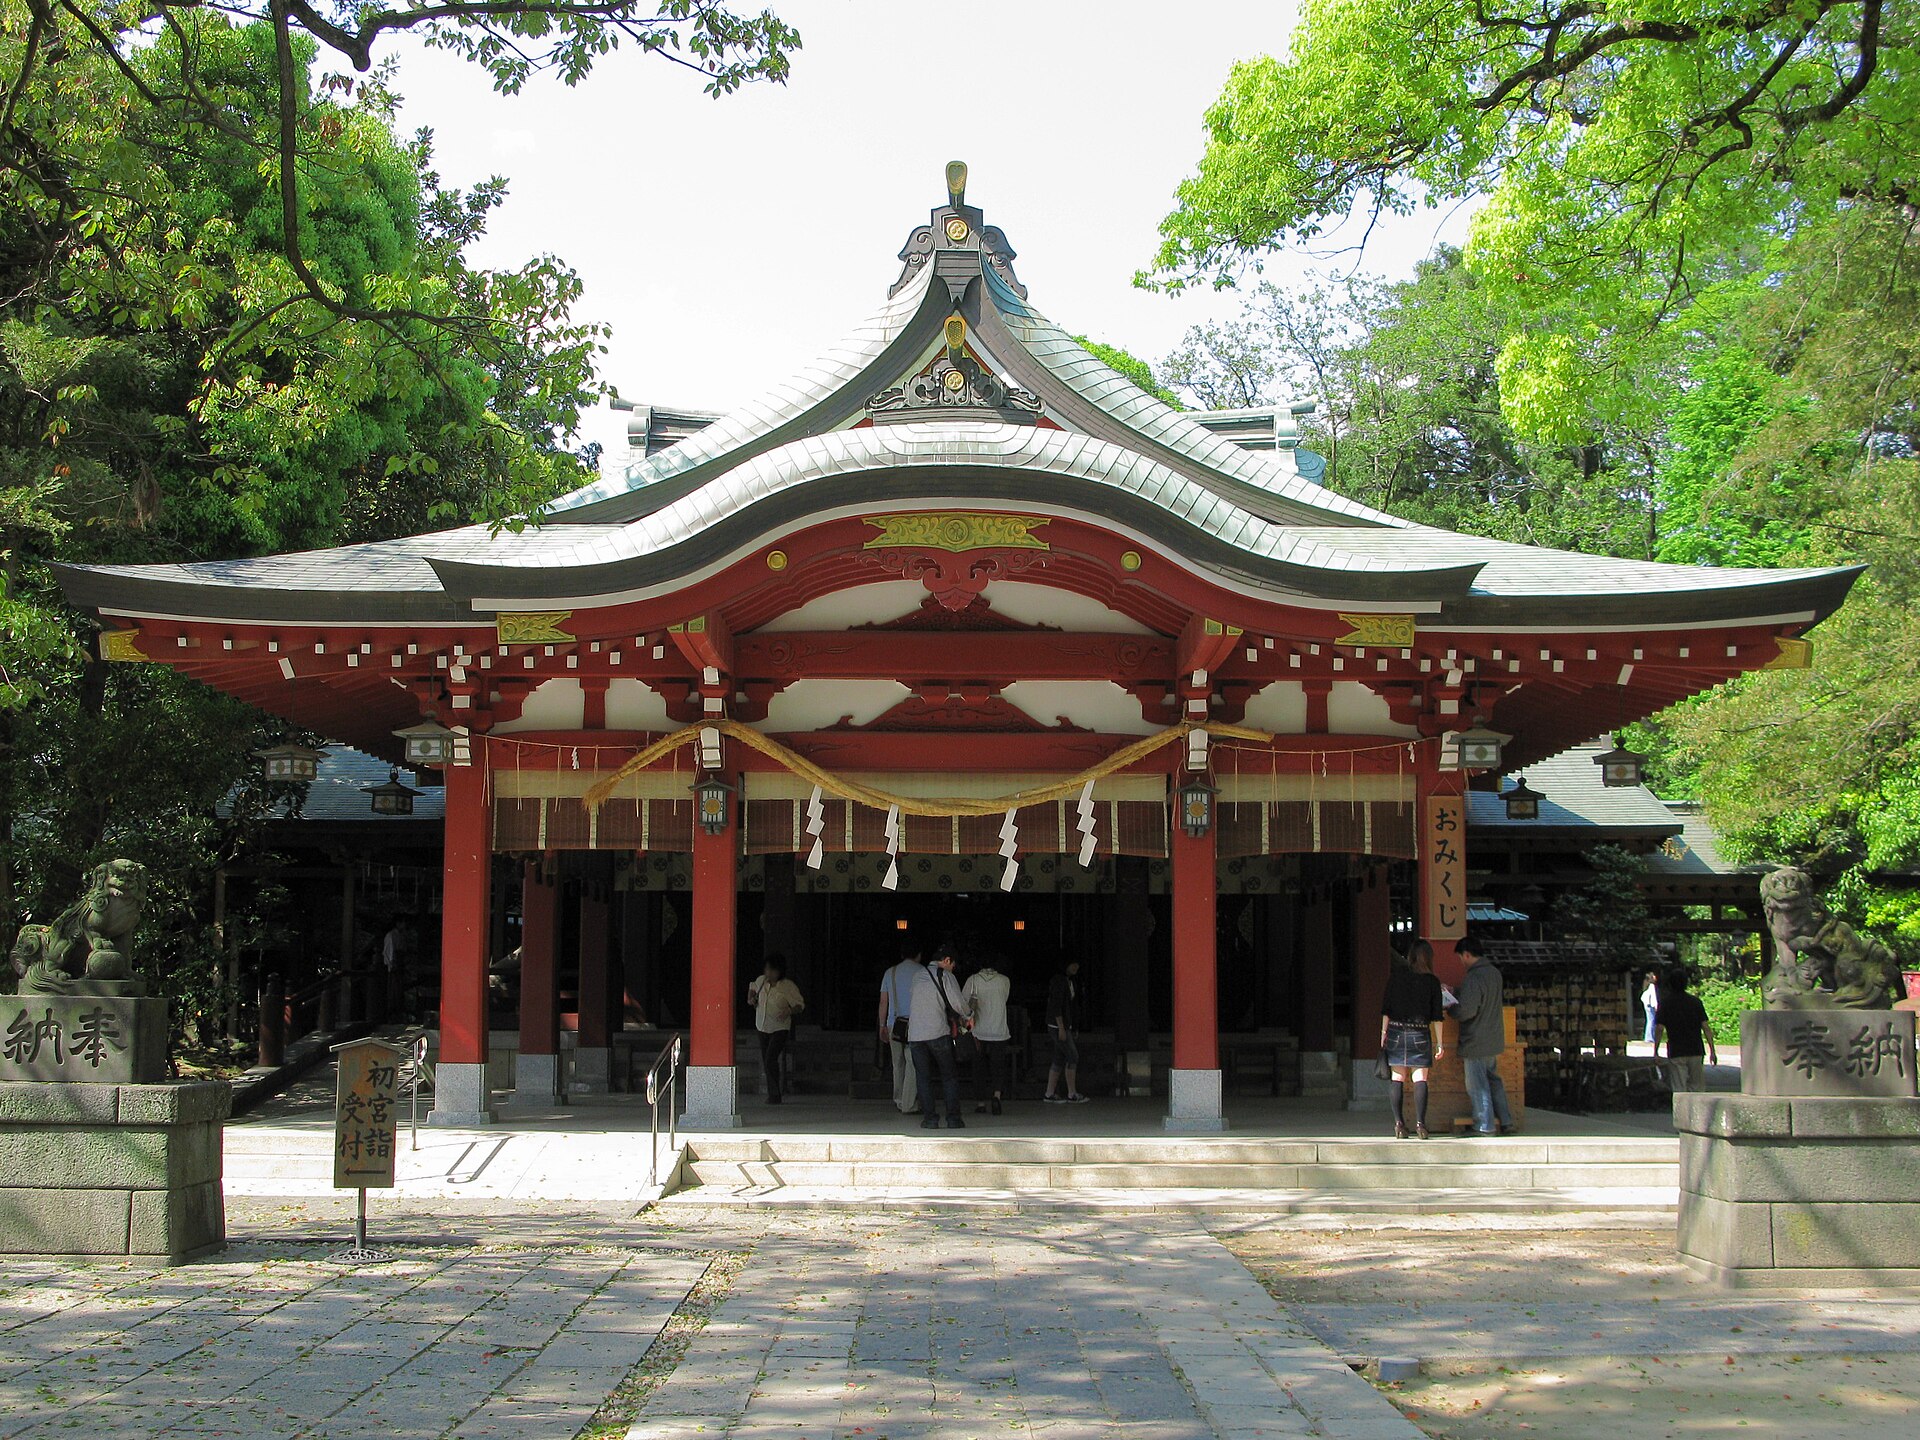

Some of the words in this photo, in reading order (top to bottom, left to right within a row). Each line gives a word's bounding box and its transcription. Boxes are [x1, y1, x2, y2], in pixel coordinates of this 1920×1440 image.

[1434, 807, 1458, 928] おみくじ
[1782, 1020, 1906, 1080] 奉納
[340, 1091, 365, 1161] 受付
[366, 1061, 395, 1159] 初宮詣
